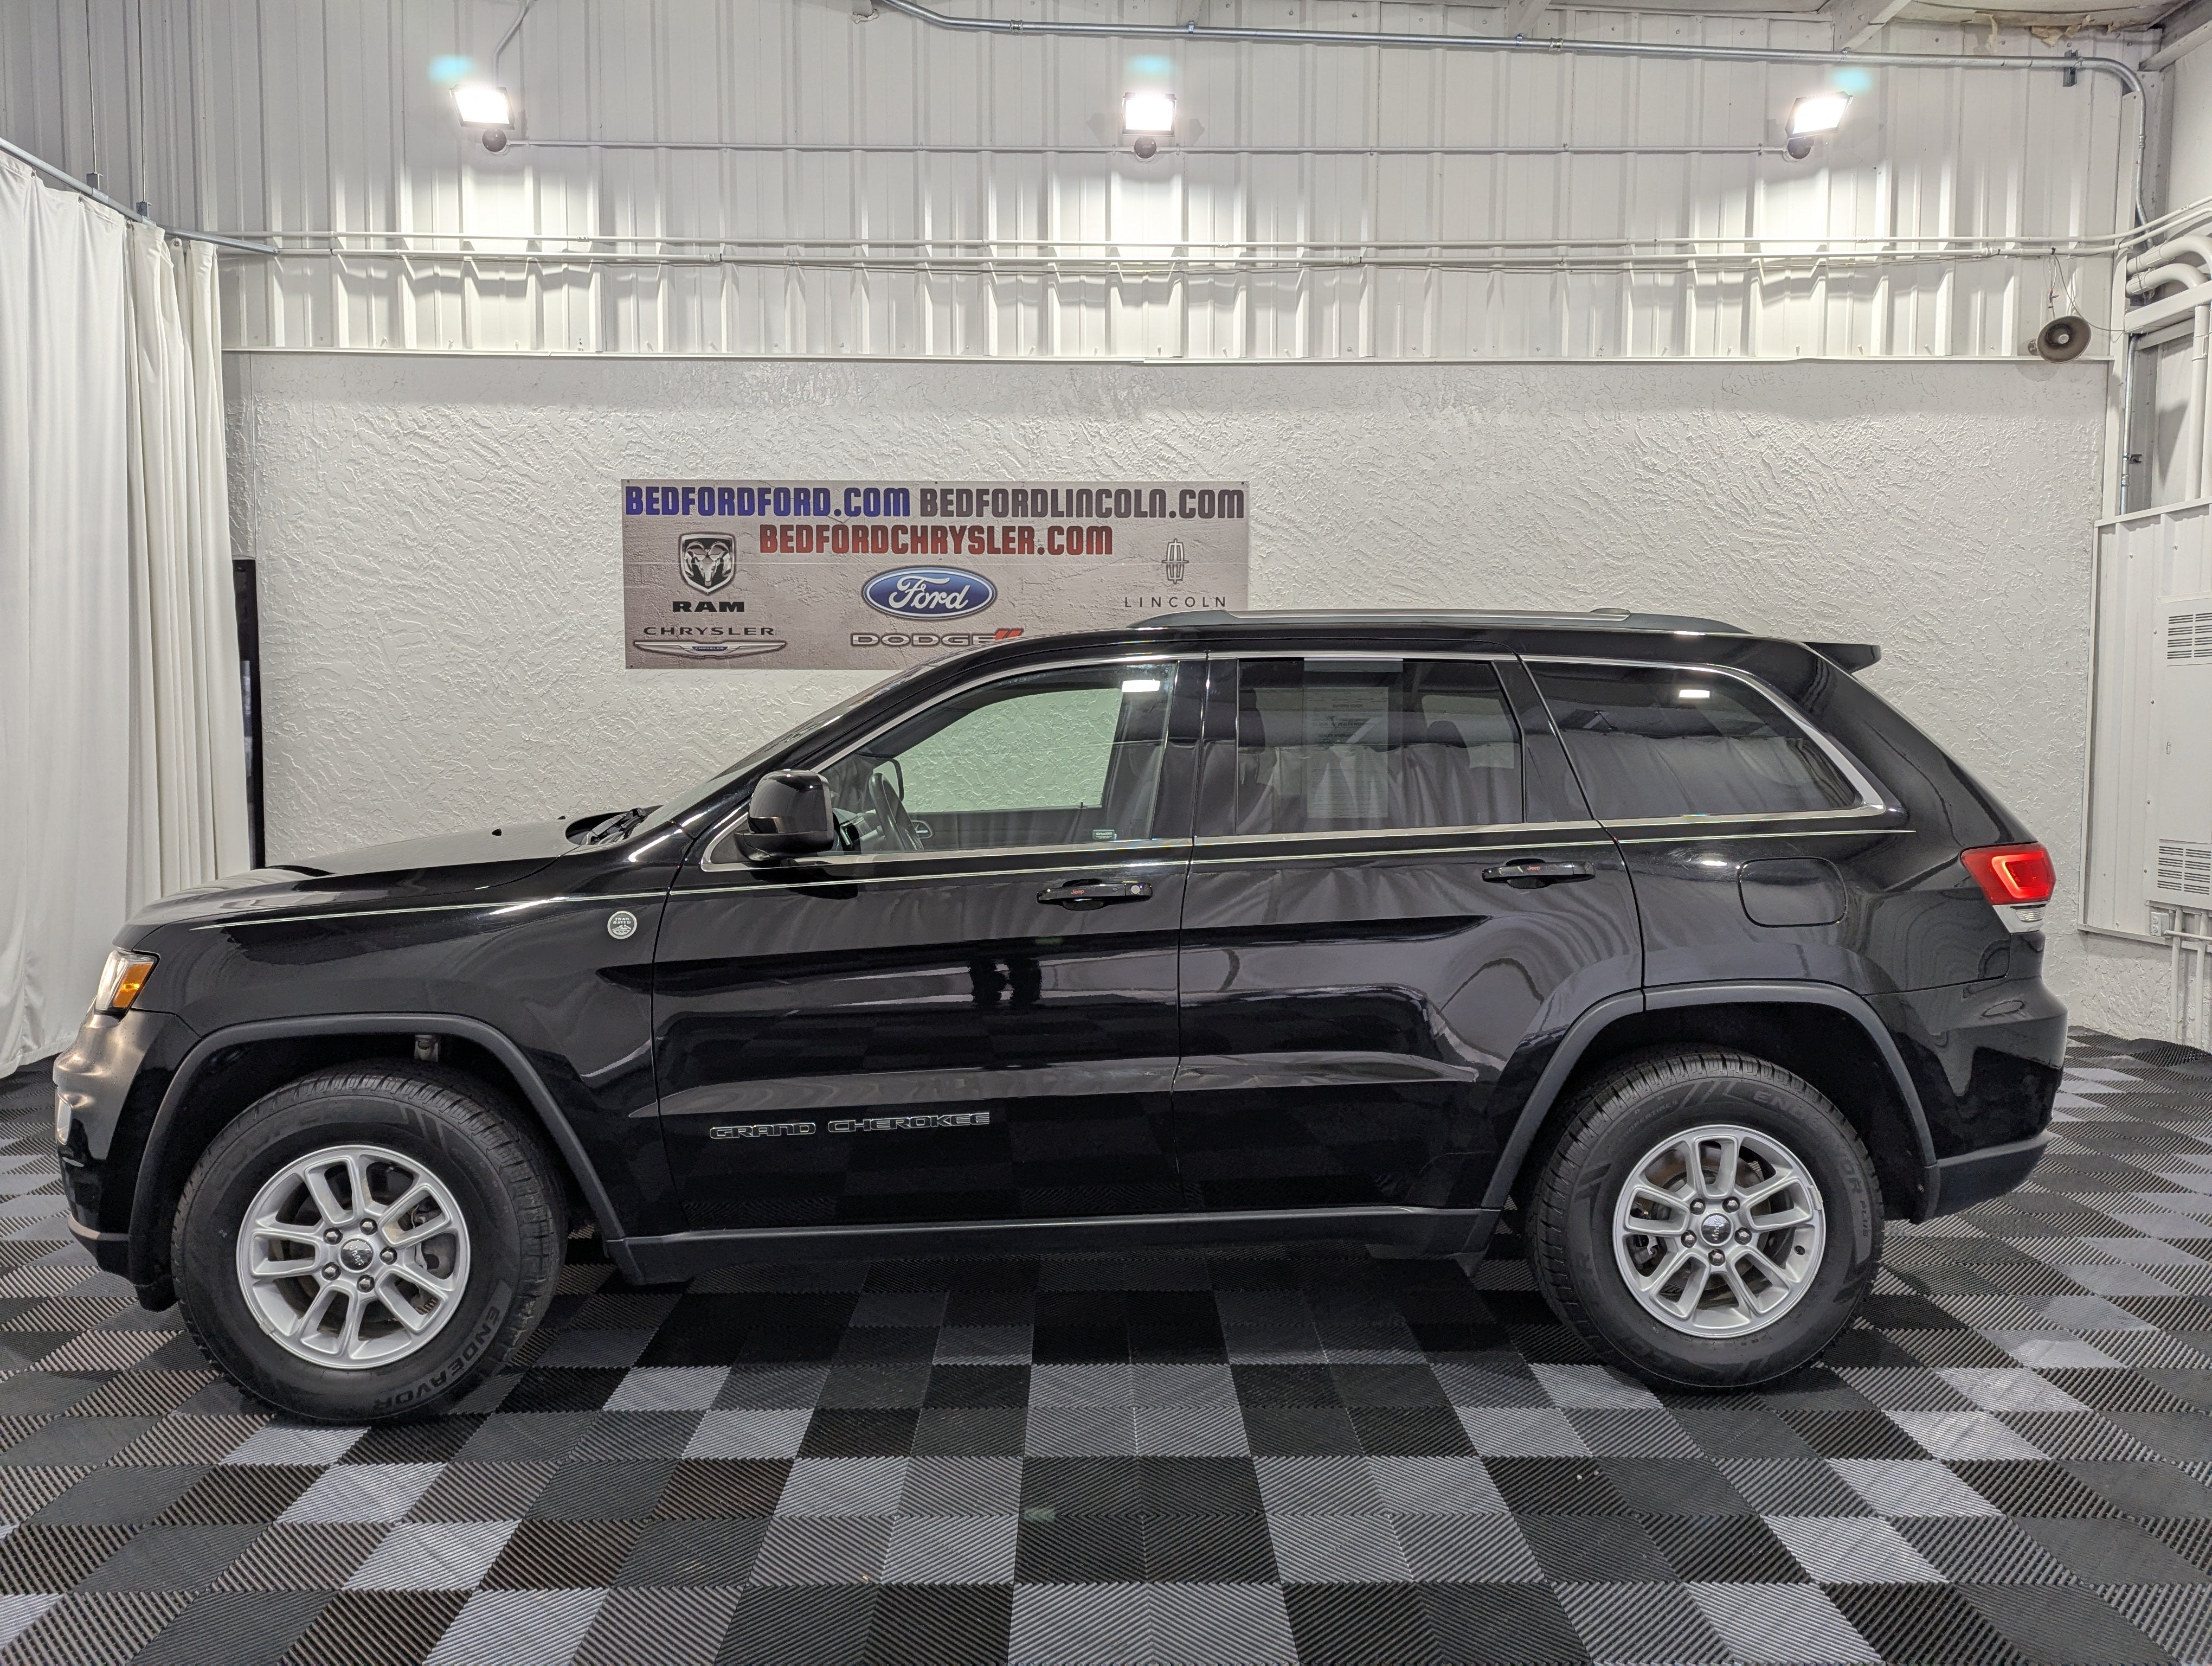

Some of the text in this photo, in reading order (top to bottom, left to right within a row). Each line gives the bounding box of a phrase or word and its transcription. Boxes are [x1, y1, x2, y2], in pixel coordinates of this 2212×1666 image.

[626, 486, 1244, 518] BEDFORDFORD.COM BEDFORDLINCOLN.COM
[759, 524, 1113, 555] BEDFORDCHRYSLER.COM
[889, 575, 970, 609] Ford
[1124, 597, 1225, 607] LINCOLN
[672, 601, 745, 613] RAM
[644, 627, 775, 636] CHRYSLER
[710, 1112, 991, 1139] GRAND CHEROKEE
[373, 1305, 500, 1411] ENDEAVOR
